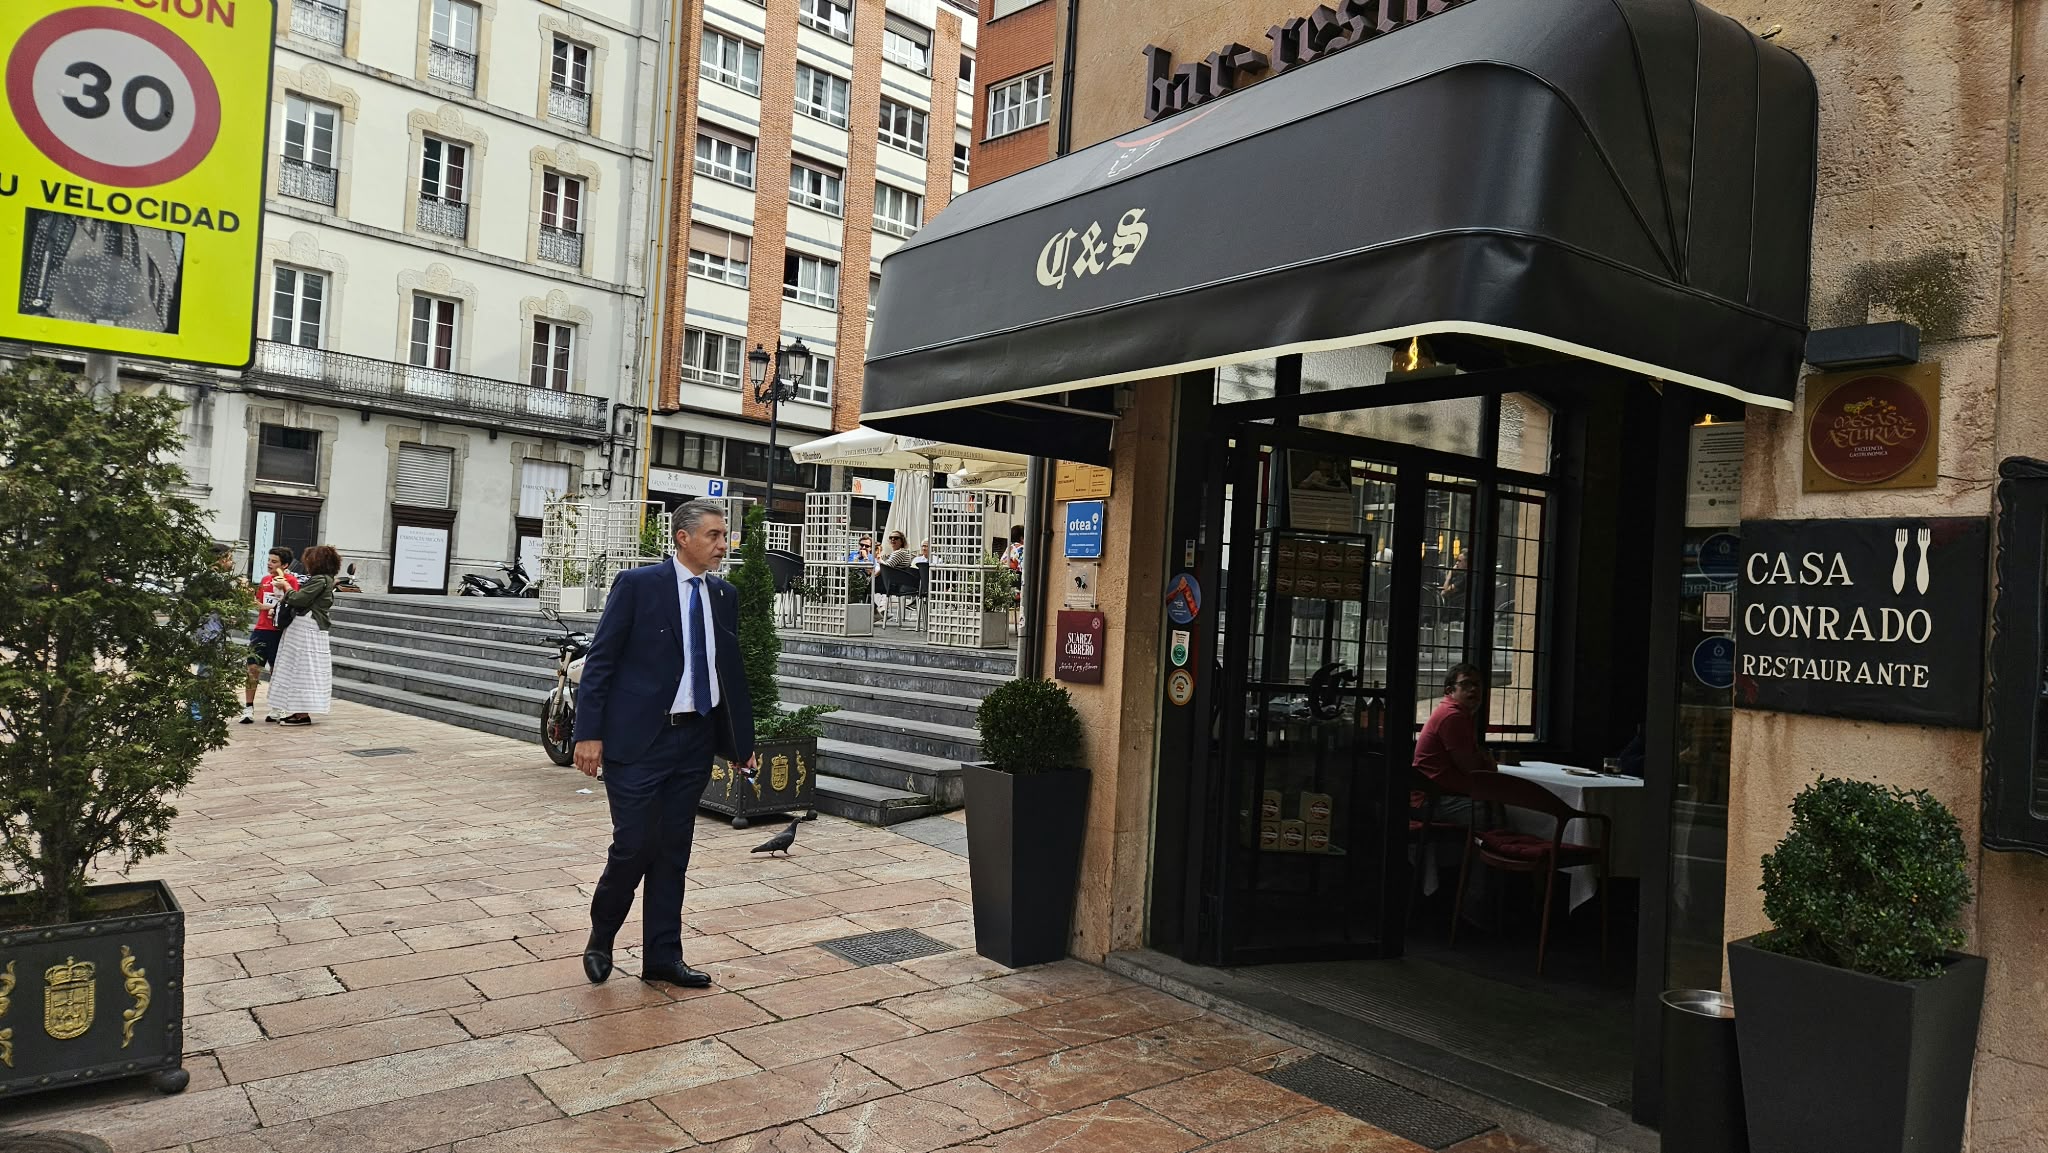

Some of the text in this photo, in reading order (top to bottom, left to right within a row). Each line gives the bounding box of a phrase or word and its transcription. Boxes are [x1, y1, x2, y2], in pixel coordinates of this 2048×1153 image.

[62, 61, 174, 132] 30
[40, 179, 240, 232] VELOCIDAD
[1825, 425, 1916, 448] ASTURIAS
[710, 481, 721, 495] P
[1746, 552, 1854, 586] CASA
[1744, 603, 1932, 644] CONRADO
[1065, 643, 1094, 656] CABRERO
[1742, 654, 1930, 688] RESTAURANTE
